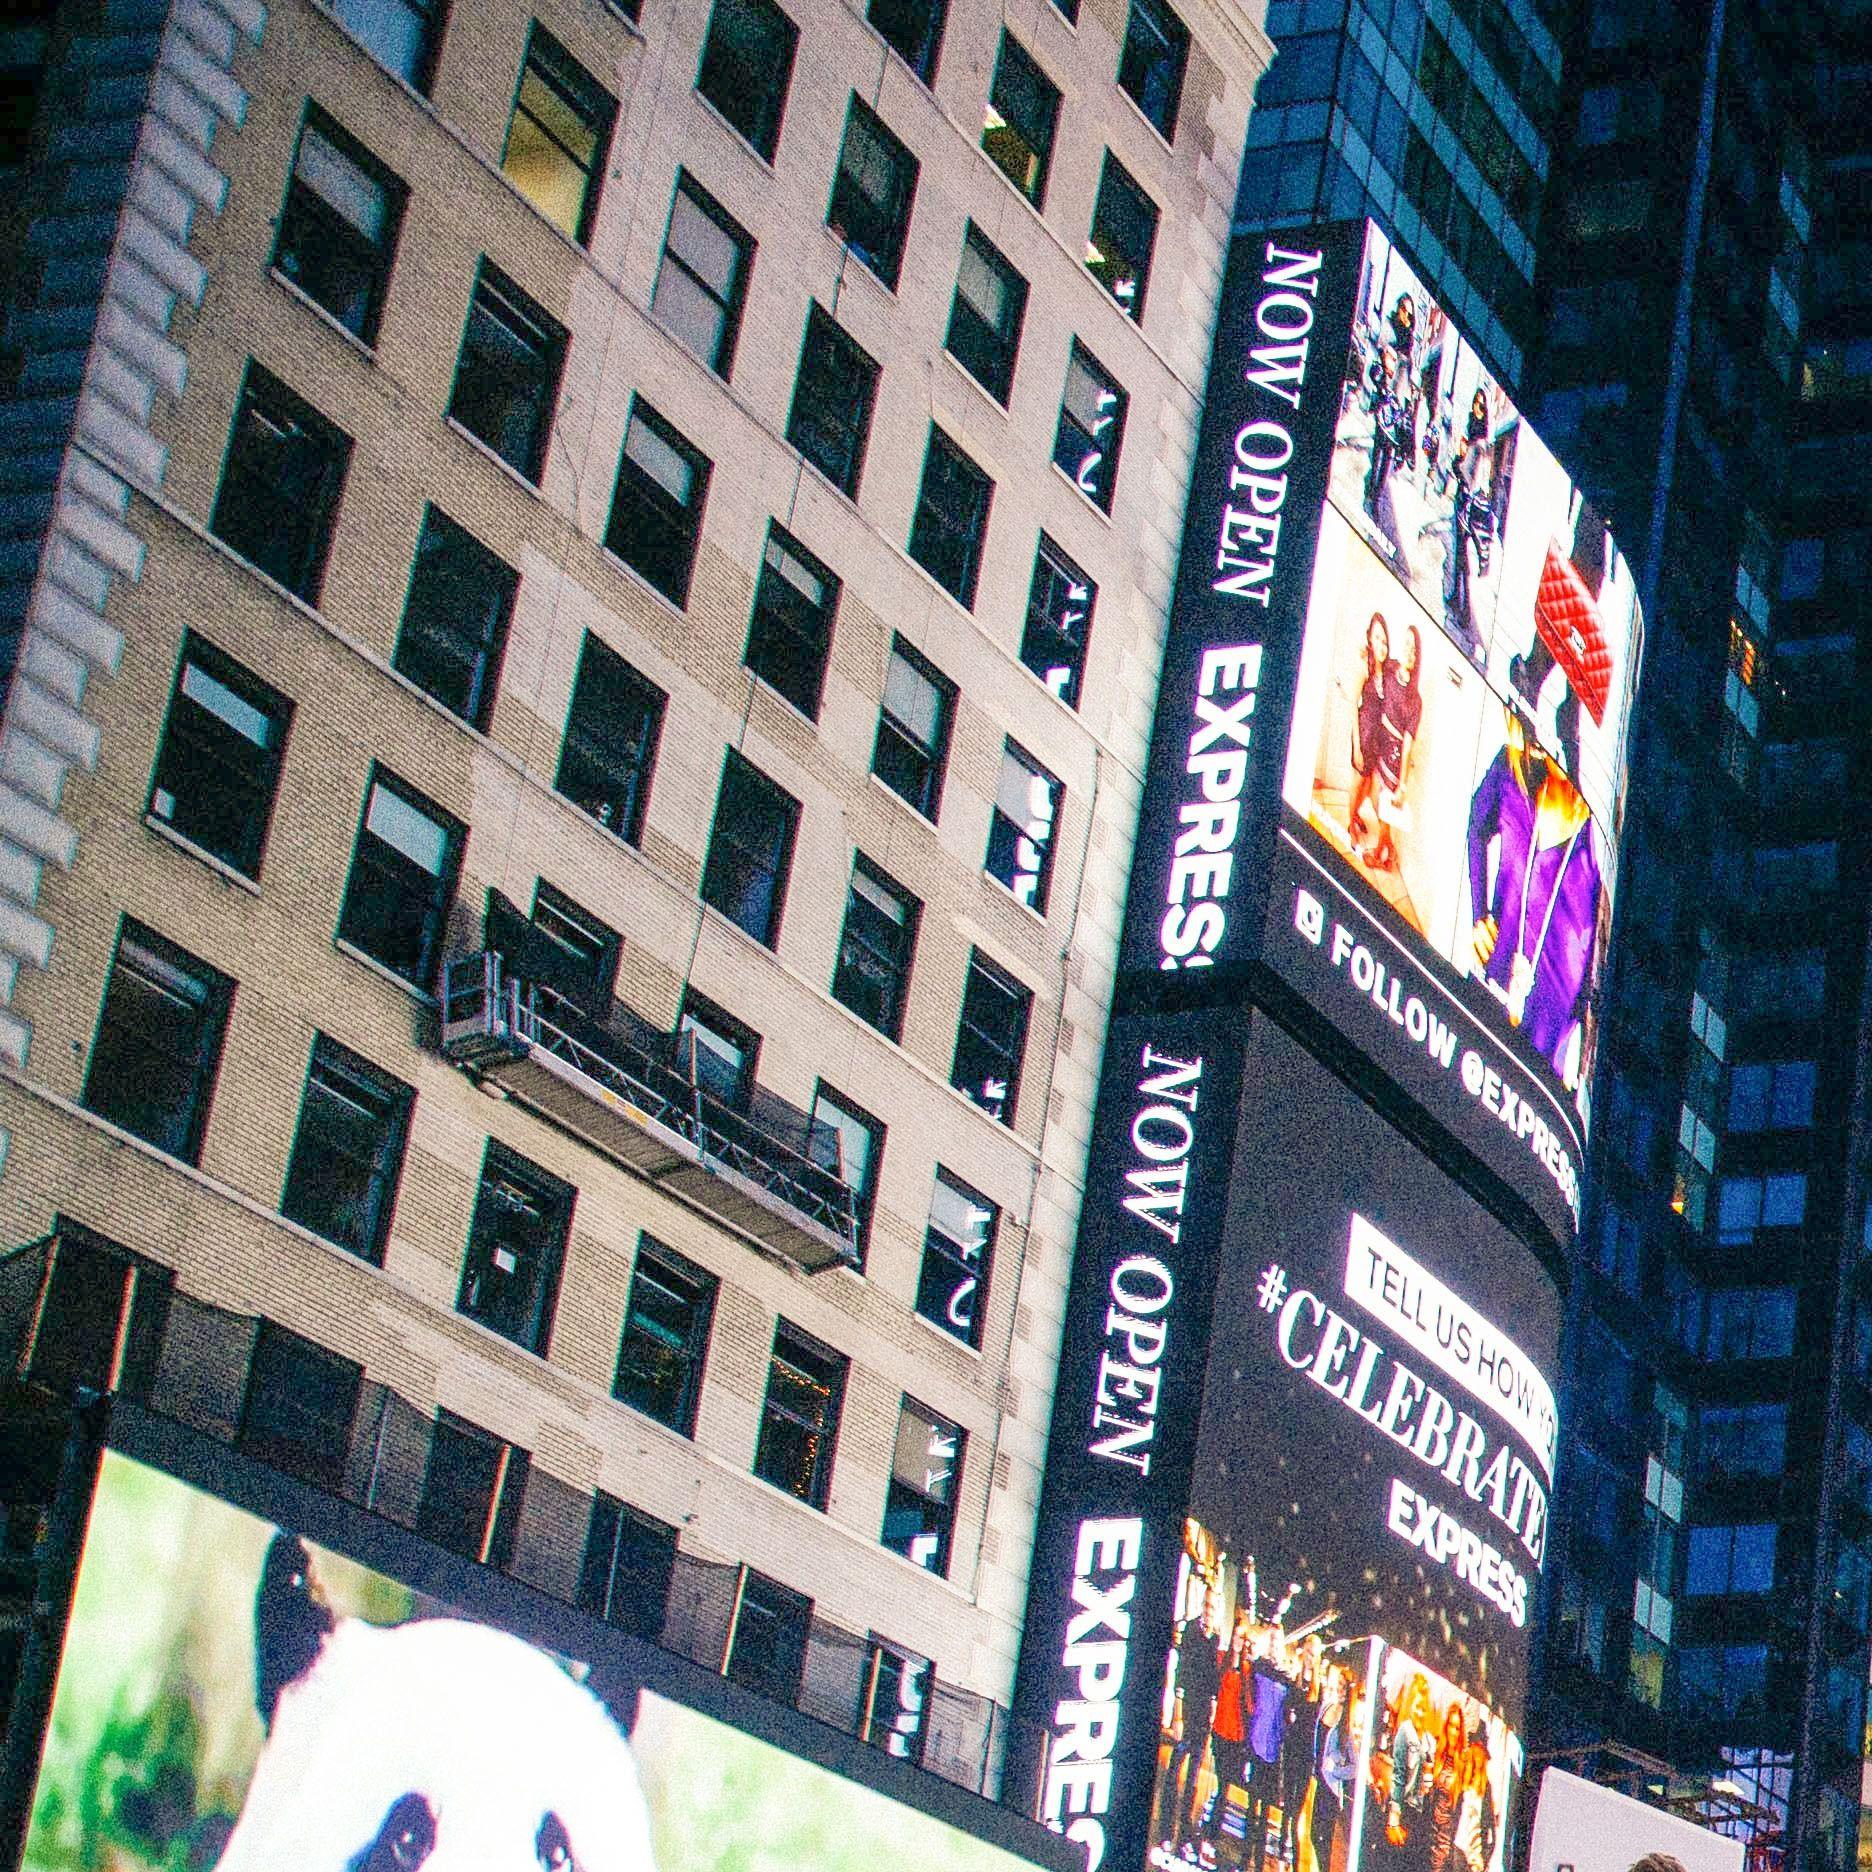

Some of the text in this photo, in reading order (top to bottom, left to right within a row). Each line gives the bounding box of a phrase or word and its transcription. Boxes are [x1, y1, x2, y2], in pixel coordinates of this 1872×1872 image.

[1159, 241, 1324, 971] NOW OPEN EXPRES
[1331, 923, 1458, 1069] FOLLOW
[1088, 1043, 1204, 1476] NOW OPEN
[1367, 1246, 1535, 1416] TELL US HOW
[1257, 1263, 1551, 1573] #CELEBRATE
[1387, 1478, 1529, 1629] EXPRESS
